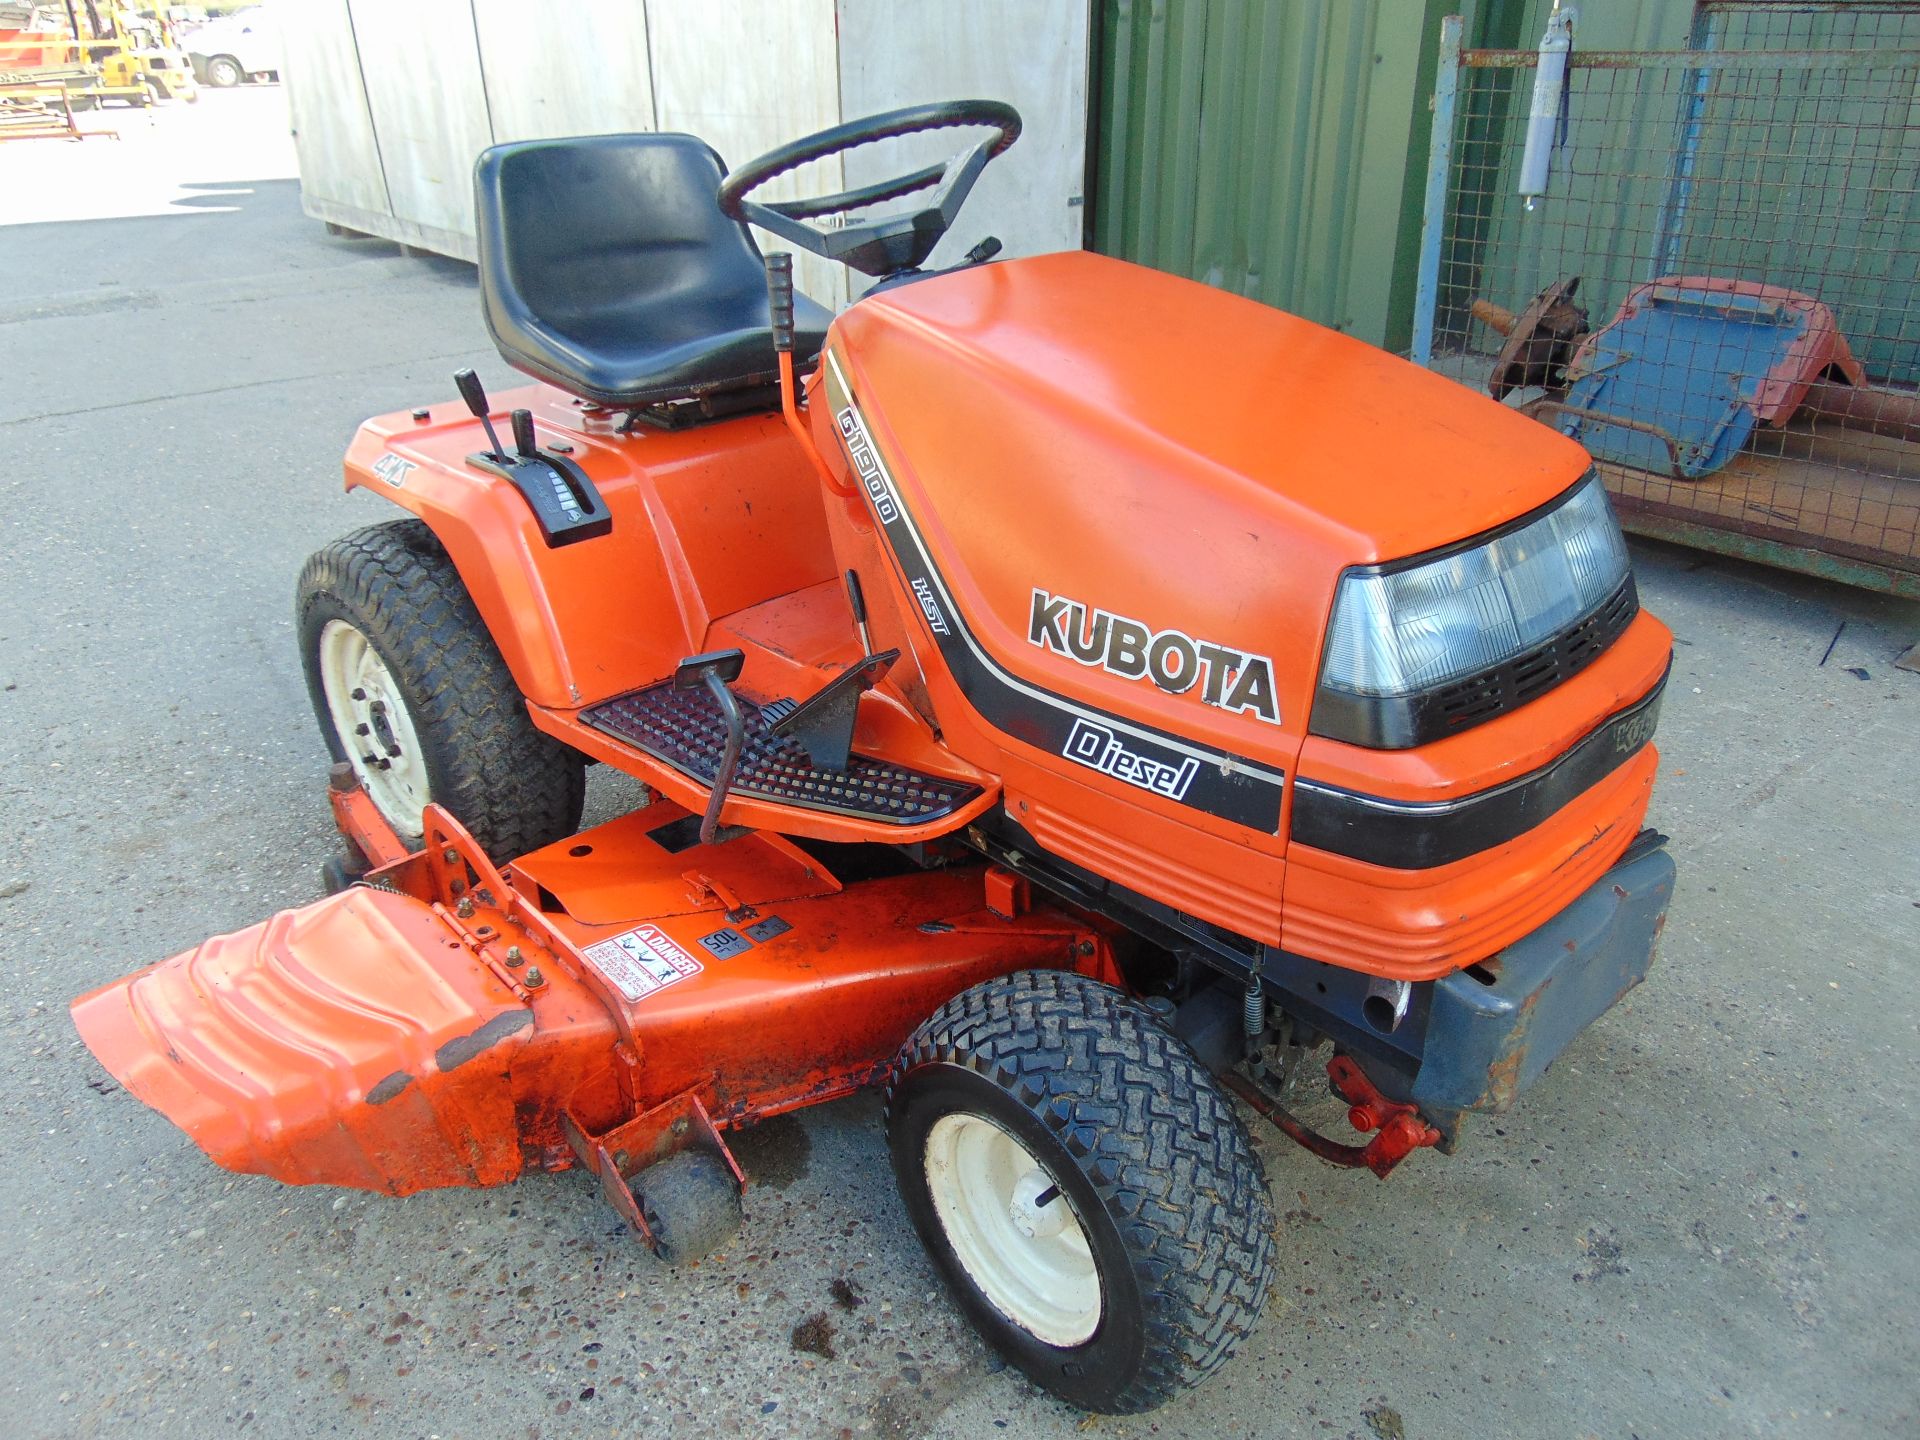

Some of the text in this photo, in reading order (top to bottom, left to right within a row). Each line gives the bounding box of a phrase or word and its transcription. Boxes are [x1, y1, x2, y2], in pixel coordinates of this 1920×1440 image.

[837, 407, 898, 524] G1900
[911, 577, 951, 636] HST
[1027, 587, 1282, 725] KUBOTA
[1062, 718, 1200, 800] Diesel
[650, 936, 697, 975] DANGER
